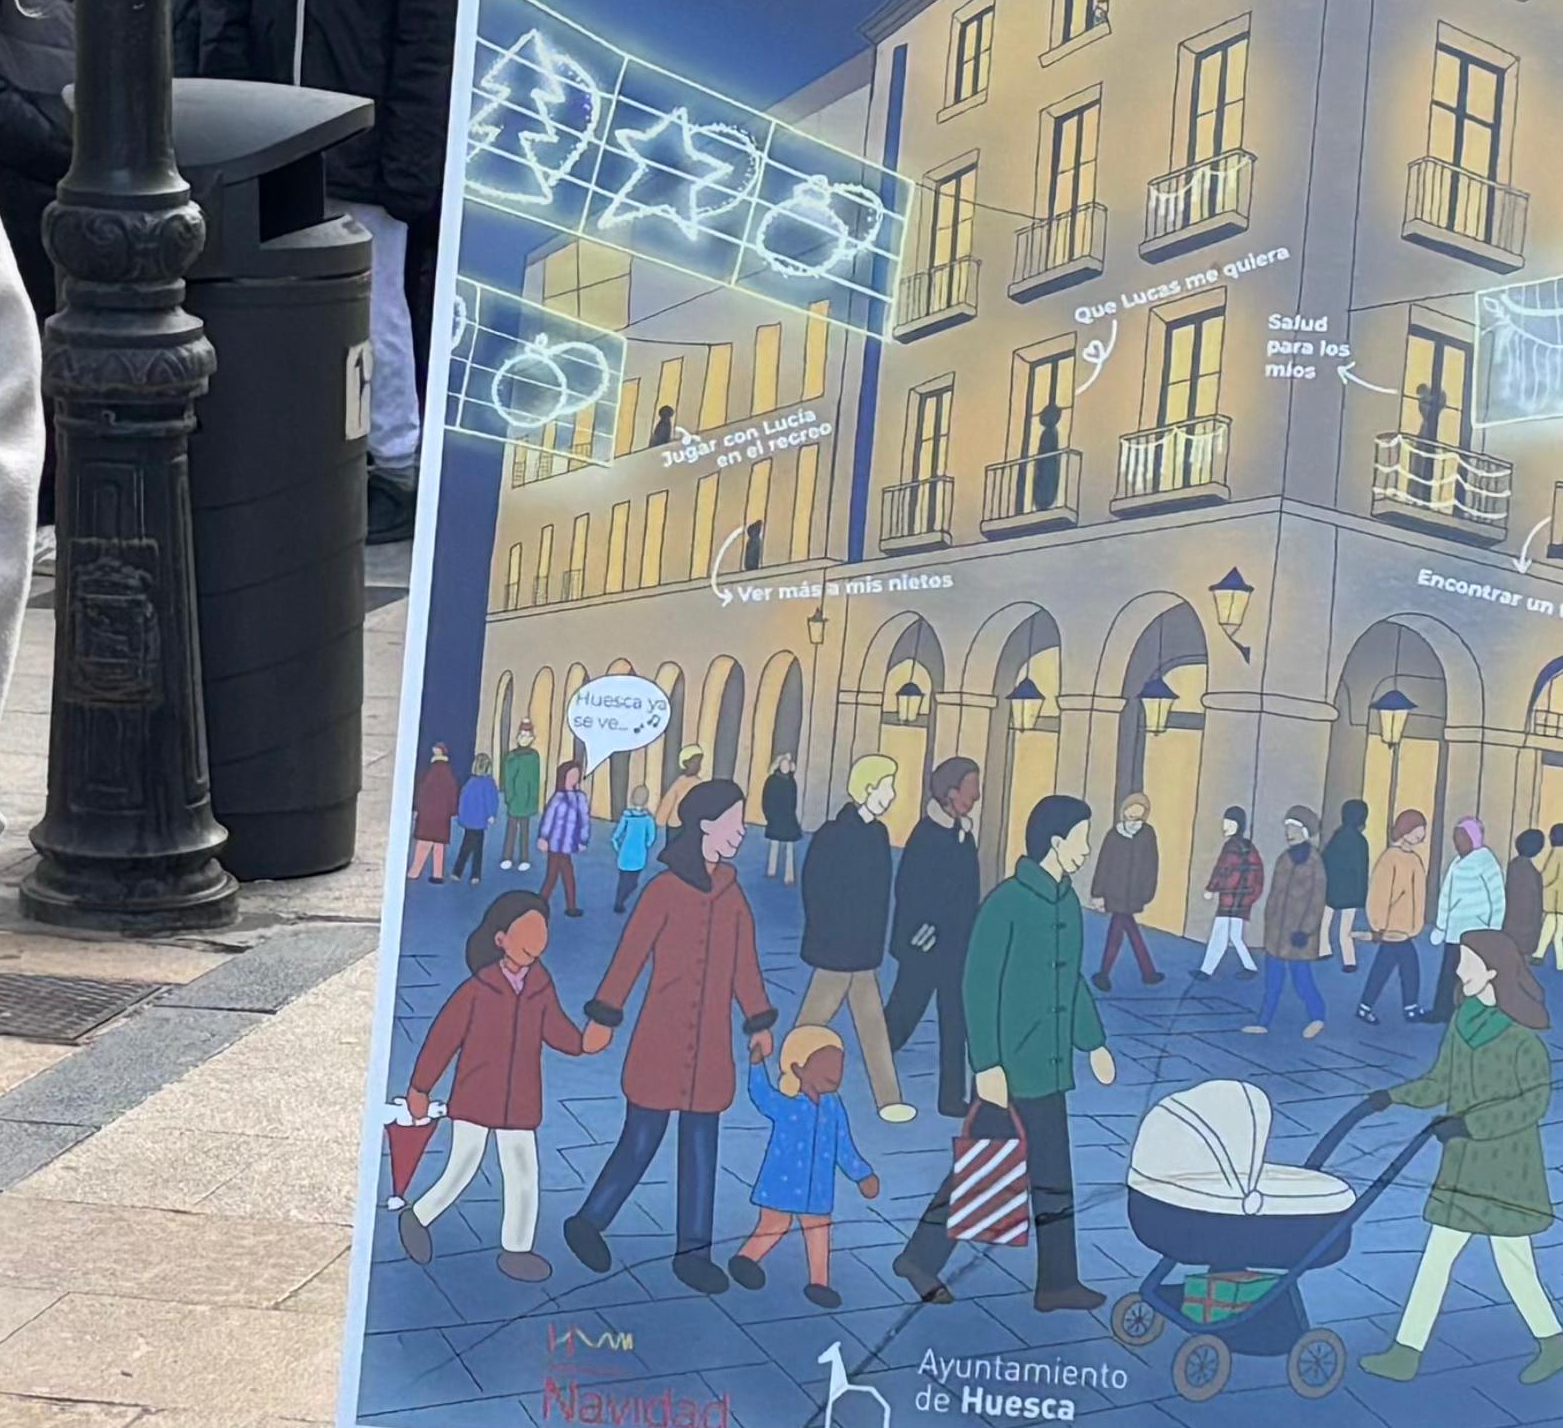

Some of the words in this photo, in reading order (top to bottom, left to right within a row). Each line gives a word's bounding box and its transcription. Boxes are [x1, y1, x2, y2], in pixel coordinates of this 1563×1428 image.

[1074, 300, 1117, 325] Que
[1121, 278, 1182, 309] Lucas
[1186, 265, 1219, 291] me
[1223, 246, 1291, 280] quiera
[1268, 313, 1328, 333] Salud
[1266, 339, 1314, 359] para
[1320, 340, 1350, 357] los
[660, 440, 716, 468] Jugar
[723, 429, 759, 449] con
[716, 451, 742, 469] en
[746, 440, 764, 460] el
[769, 422, 833, 454] recreo
[737, 586, 772, 603] Ver
[779, 579, 822, 600] más
[825, 582, 840, 596] a
[846, 576, 884, 595] mis
[888, 572, 956, 591] nietos
[1417, 568, 1523, 607] Encontrar
[1526, 597, 1554, 615] un
[576, 691, 642, 710] Huesca
[647, 698, 667, 713] ya
[573, 715, 593, 729] se
[918, 1347, 1128, 1389] Ayuntamiento
[915, 1384, 950, 1413] de
[961, 1385, 1075, 1421] Huesca
